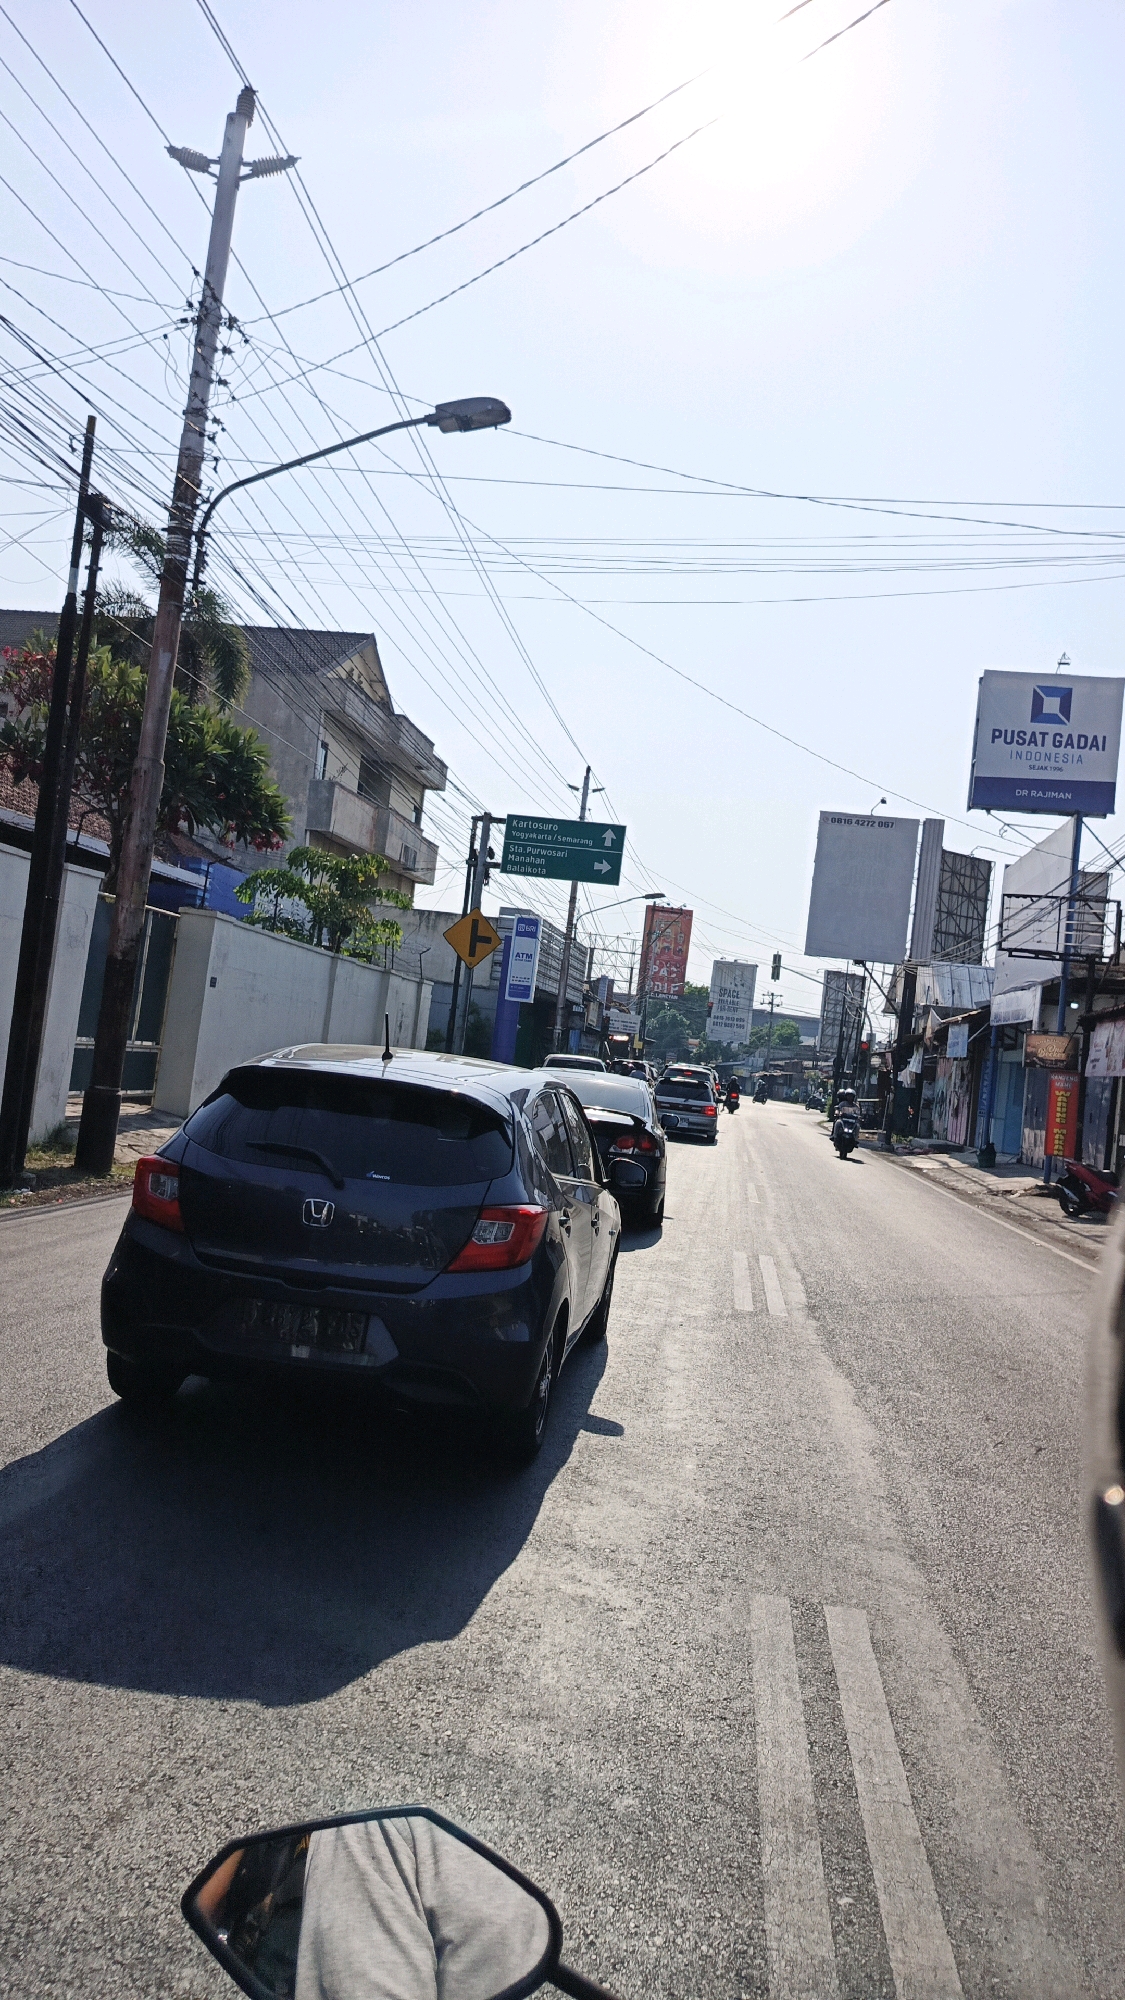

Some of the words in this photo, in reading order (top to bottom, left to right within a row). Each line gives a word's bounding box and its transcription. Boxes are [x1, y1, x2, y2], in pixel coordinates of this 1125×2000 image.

[990, 728, 1049, 748] PUSAT
[1052, 732, 1107, 752] GADAI
[1010, 750, 1084, 764] INDONESIA
[1031, 790, 1072, 799] RAJIMAN
[512, 819, 558, 831] Kartosuro
[854, 819, 876, 827] 4272
[511, 830, 552, 840] Yogyakarta
[558, 835, 593, 846] Semarang
[508, 854, 545, 865] Manahan
[507, 864, 546, 874] Balaikota
[719, 988, 740, 999] SPACE
[1055, 1091, 1071, 1124] WARUNG
[1053, 1128, 1067, 1156] MAKAN
